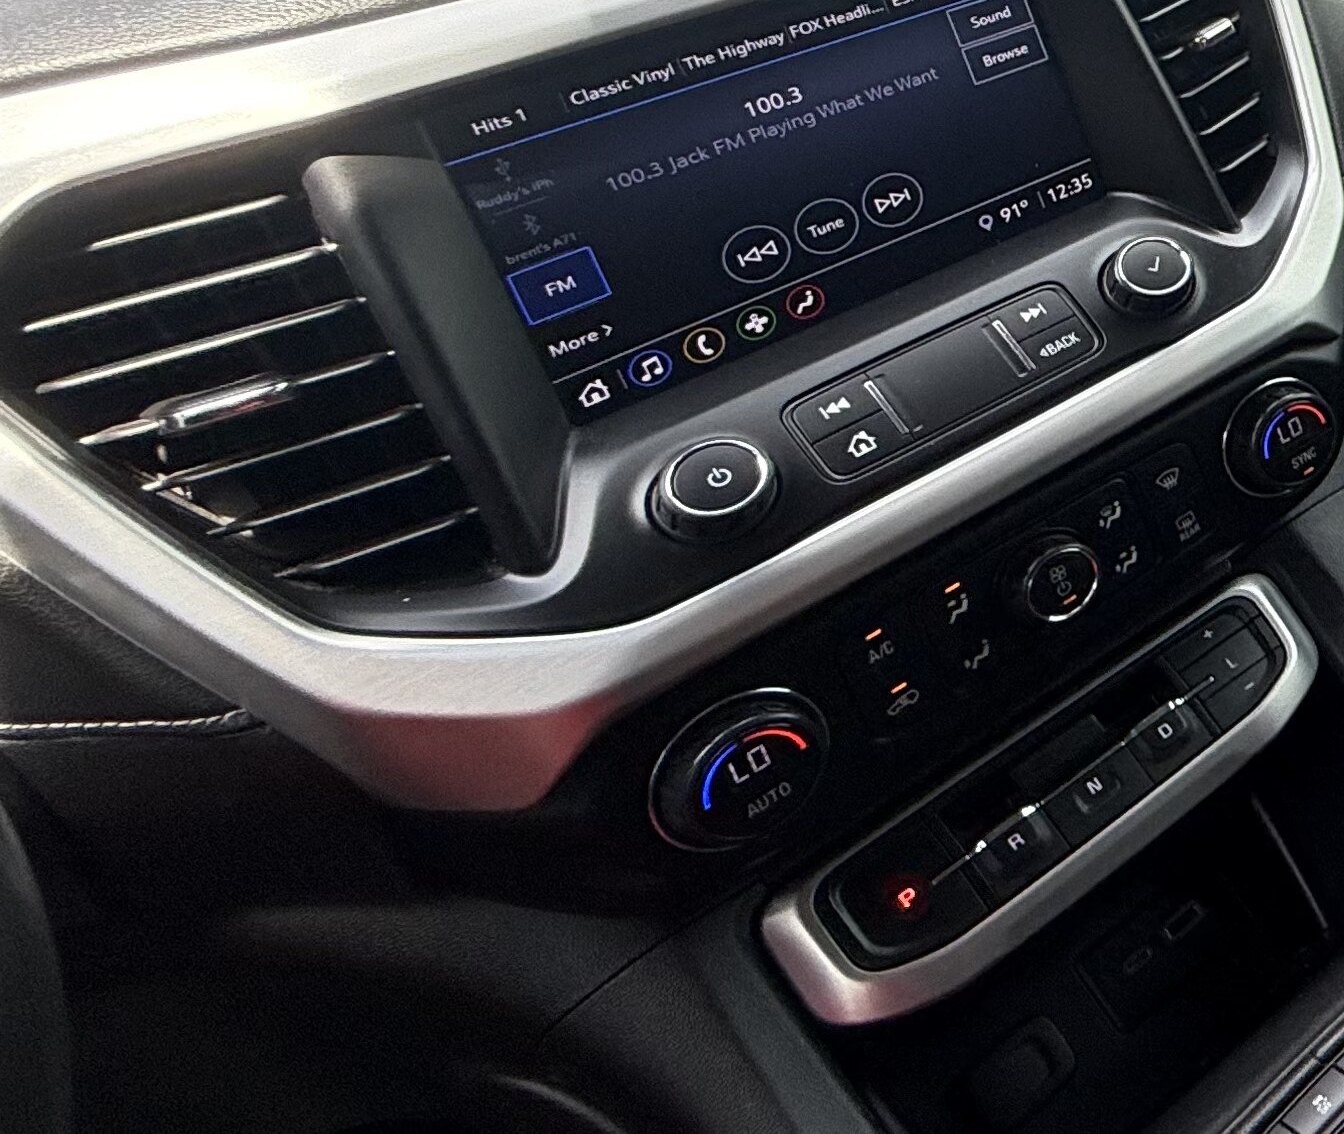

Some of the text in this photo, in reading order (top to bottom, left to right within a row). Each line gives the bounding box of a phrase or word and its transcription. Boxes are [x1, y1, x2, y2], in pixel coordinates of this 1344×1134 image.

[788, 18, 824, 39] FOX
[969, 5, 1012, 29] Sound
[681, 32, 785, 71] The Highway
[981, 44, 1029, 68] Browse
[569, 62, 676, 106] Classic Vinyl
[743, 86, 804, 118] 100.3
[470, 108, 527, 136] Hits 1
[605, 67, 941, 192] 100.3 Jack FM Playing What We Want
[1047, 173, 1094, 204] 12:35
[807, 216, 846, 239] Tune
[544, 275, 578, 297] FM
[547, 329, 600, 358] More
[1044, 331, 1081, 357] BACK
[1276, 416, 1304, 444] LO
[1291, 446, 1318, 470] SYNC
[868, 640, 895, 665] A/C
[727, 743, 772, 785] LO
[1086, 776, 1104, 795] N
[747, 781, 792, 817] AUTO
[1007, 832, 1026, 851] R
[897, 886, 917, 909] P
